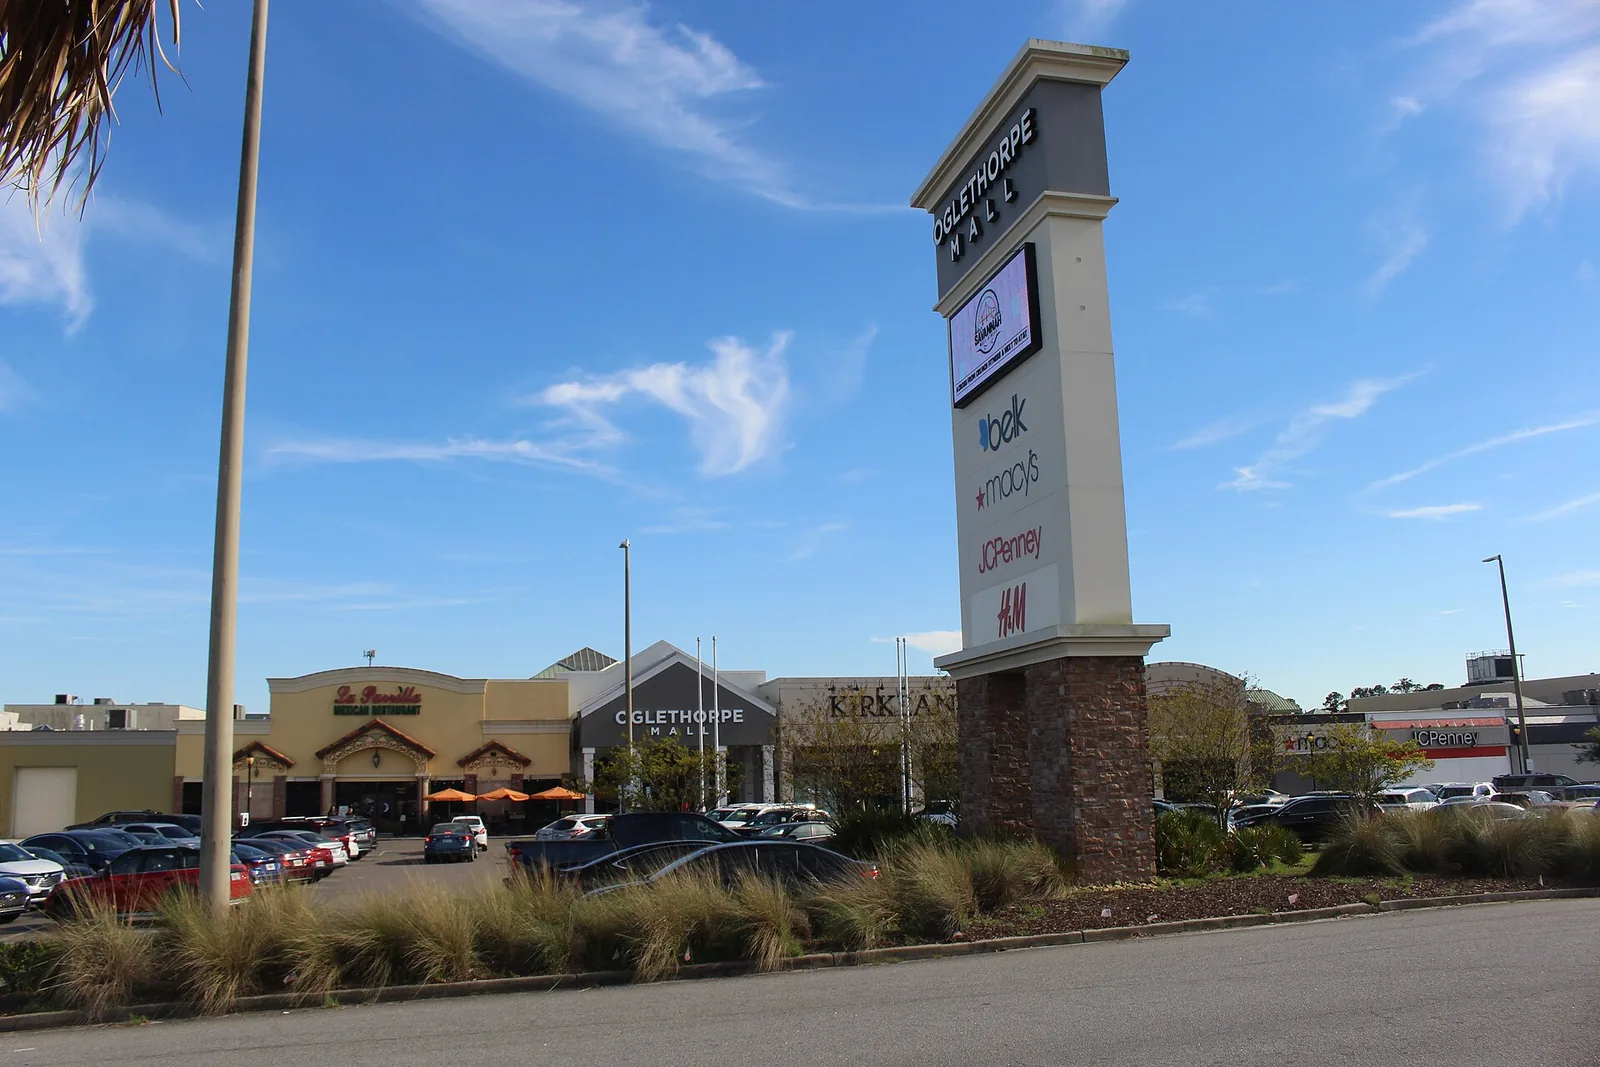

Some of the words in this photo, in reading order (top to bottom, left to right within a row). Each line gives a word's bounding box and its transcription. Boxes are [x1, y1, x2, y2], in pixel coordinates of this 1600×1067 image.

[934, 108, 1034, 246] OGLETHORPE
[950, 178, 1015, 262] MALL
[988, 393, 1028, 451] belk
[986, 449, 1039, 507] macy's
[978, 525, 1042, 574] JCPenney
[997, 582, 1026, 638] H&M
[333, 705, 369, 716] MEXICAN
[371, 705, 422, 716] RESTAURANT
[334, 685, 356, 704] La
[828, 695, 957, 718] KRKAN
[615, 709, 744, 724] OGLETHORPE
[650, 726, 709, 736] MALL
[1413, 730, 1479, 748] JCPenney
